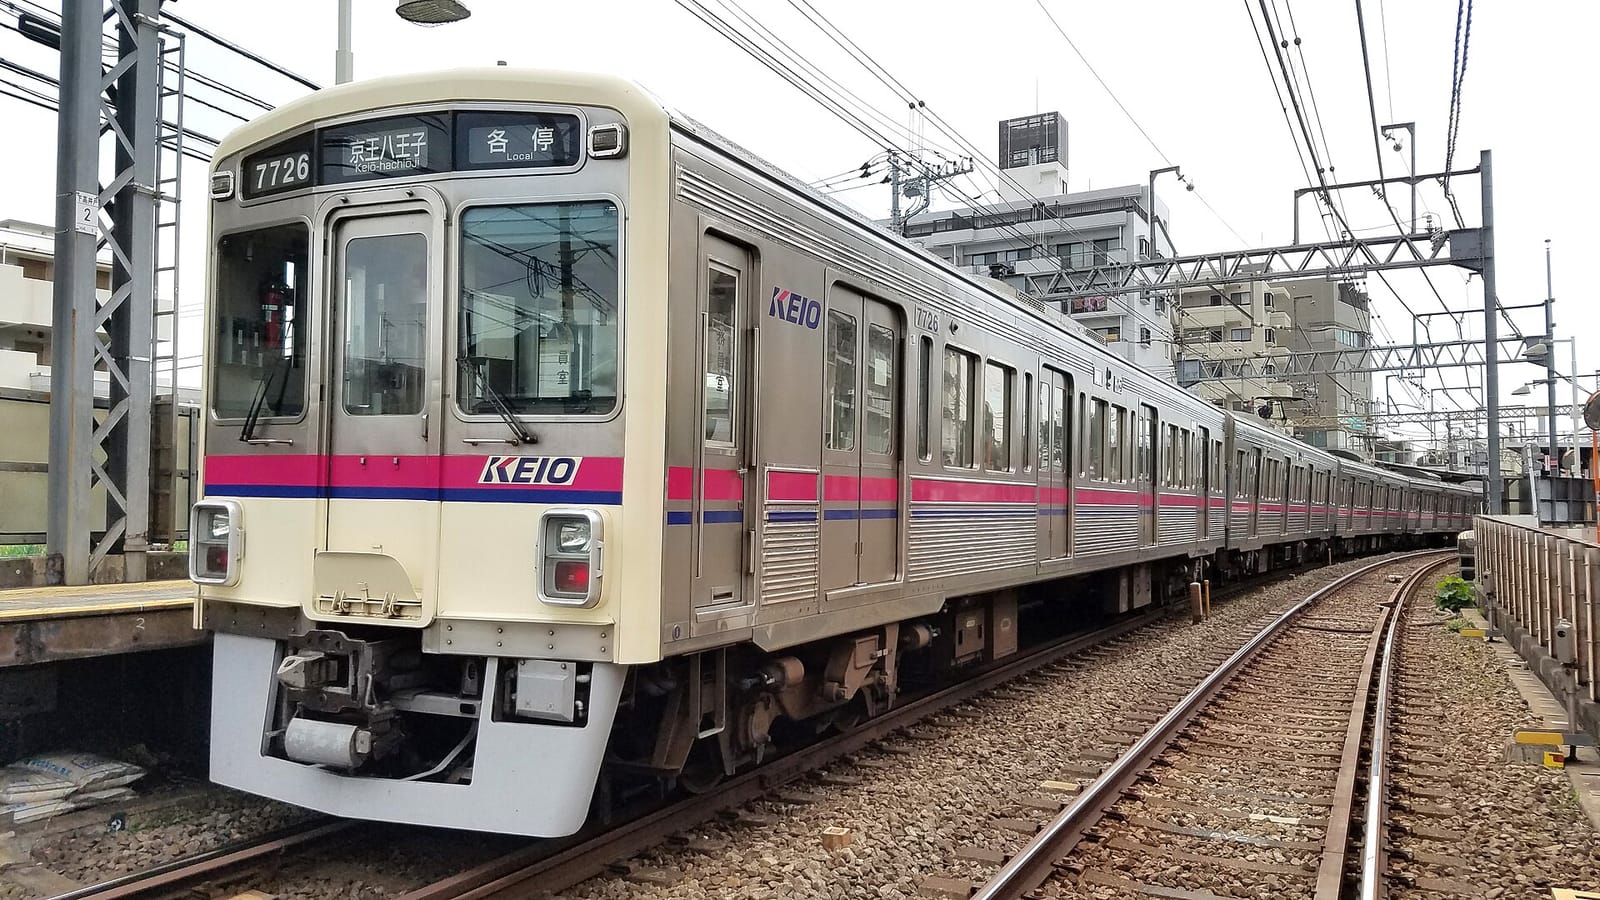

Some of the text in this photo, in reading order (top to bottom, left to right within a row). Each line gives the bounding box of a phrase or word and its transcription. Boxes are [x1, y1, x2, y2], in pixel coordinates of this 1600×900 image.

[350, 132, 426, 163] 京王八王子
[507, 152, 533, 160] Local
[256, 154, 309, 188] 7726
[84, 208, 91, 221] 2
[769, 286, 821, 329] KEIO
[917, 308, 938, 332] 7726
[483, 456, 576, 483] KEIO
